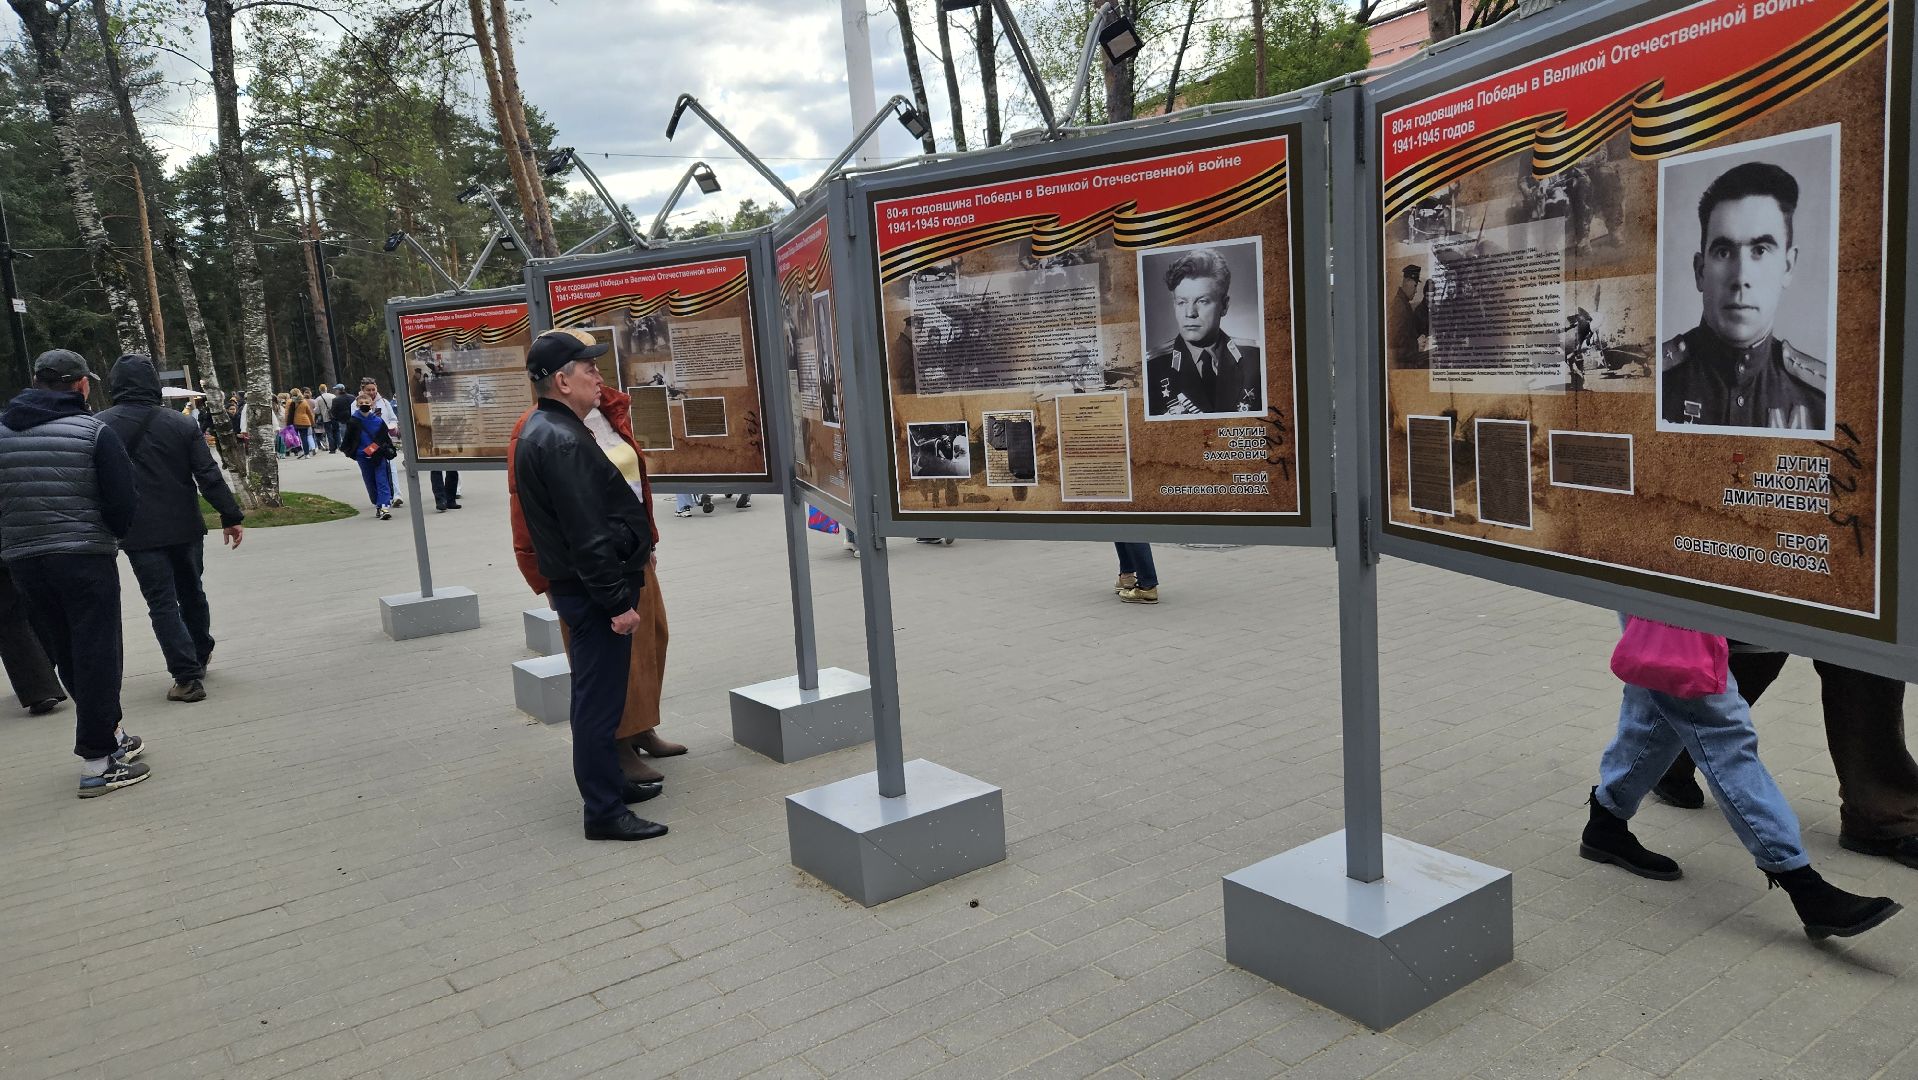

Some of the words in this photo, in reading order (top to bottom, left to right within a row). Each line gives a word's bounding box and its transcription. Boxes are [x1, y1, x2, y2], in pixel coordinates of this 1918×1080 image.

[1392, 117, 1412, 135] 80-я
[1414, 98, 1474, 128] годовщина
[1477, 80, 1527, 107] Победы
[1531, 76, 1540, 91] в
[1543, 50, 1606, 87] Великой
[1611, 3, 1746, 64] Отечественной
[1753, 0, 1815, 19] вой
[1392, 128, 1440, 155] 1941-1945
[1443, 120, 1475, 140] годов
[886, 207, 909, 219] 80-я
[911, 199, 972, 215] годовщина
[975, 190, 1022, 206] Победы
[1025, 189, 1033, 199] в
[1036, 178, 1089, 197] Великой
[1092, 161, 1194, 188] Отечественной
[1198, 155, 1242, 172] войне
[887, 216, 940, 235] 1941-1945
[942, 213, 975, 227] годов
[600, 278, 624, 288] Победы
[657, 267, 706, 281] Отечественной
[1217, 427, 1266, 438] КАЛУГИН
[1203, 450, 1267, 461] ЗАХАРОВИЧ
[1776, 455, 1830, 473] ДУГИН
[1232, 471, 1268, 483] ГЕРОЙ
[1754, 472, 1830, 494] НИКОЛАЙ
[1160, 485, 1227, 495] СОВЕТСКОГО
[1228, 485, 1269, 495] СОЮЗА
[1723, 489, 1830, 514] ДМИТРИЕВИЧ
[1777, 532, 1829, 554] ГЕРОЙ
[1674, 536, 1766, 563] СОВЕТСКОГО
[1769, 550, 1830, 575] СОЮЗА
